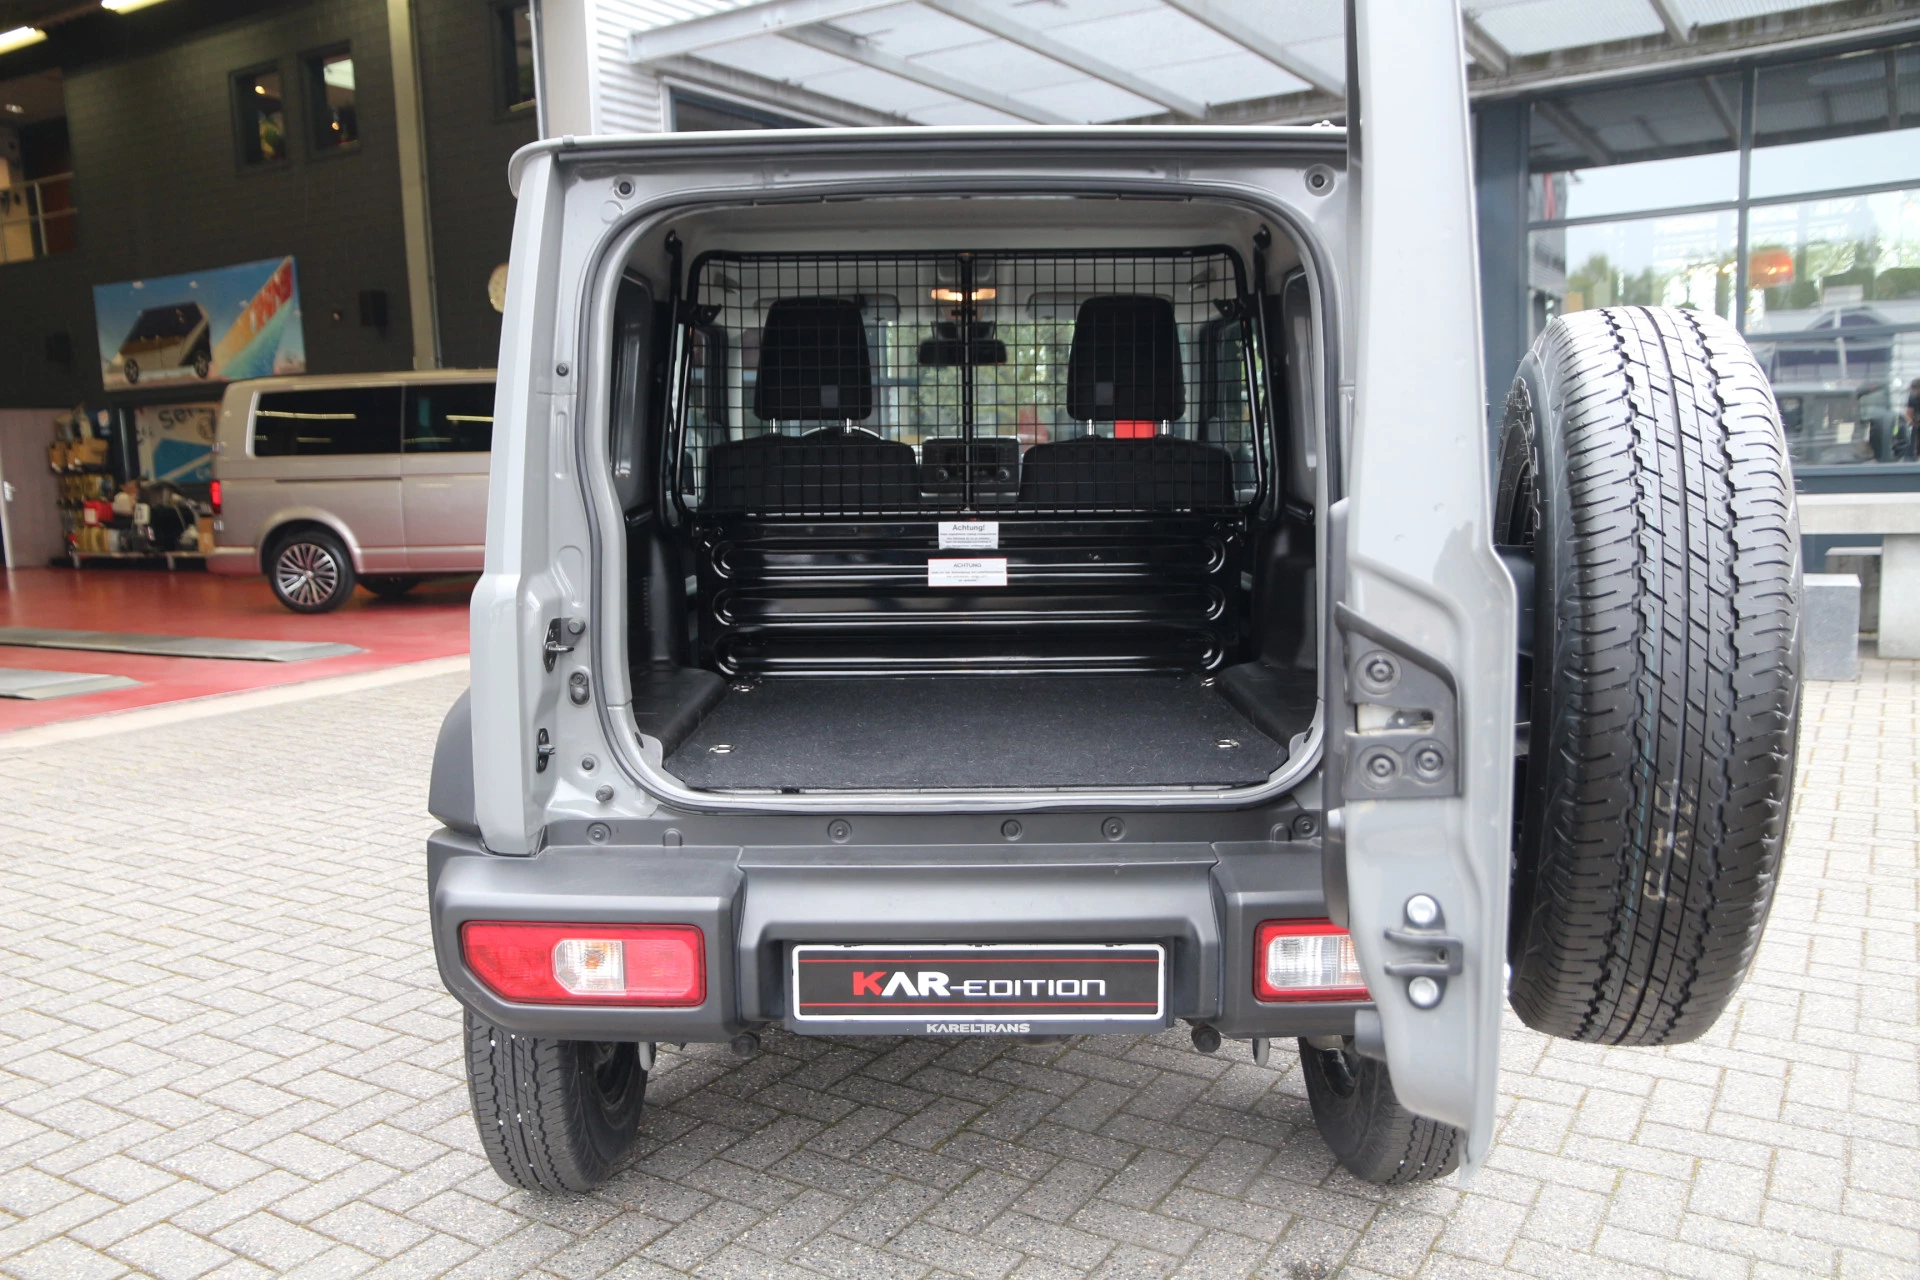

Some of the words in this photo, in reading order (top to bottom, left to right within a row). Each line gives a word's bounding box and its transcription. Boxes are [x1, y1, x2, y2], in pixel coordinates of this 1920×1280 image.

[952, 524, 986, 532] Achtung!
[852, 971, 1106, 997] KAR-EDITION
[926, 1023, 1031, 1033] KARELTRANS
